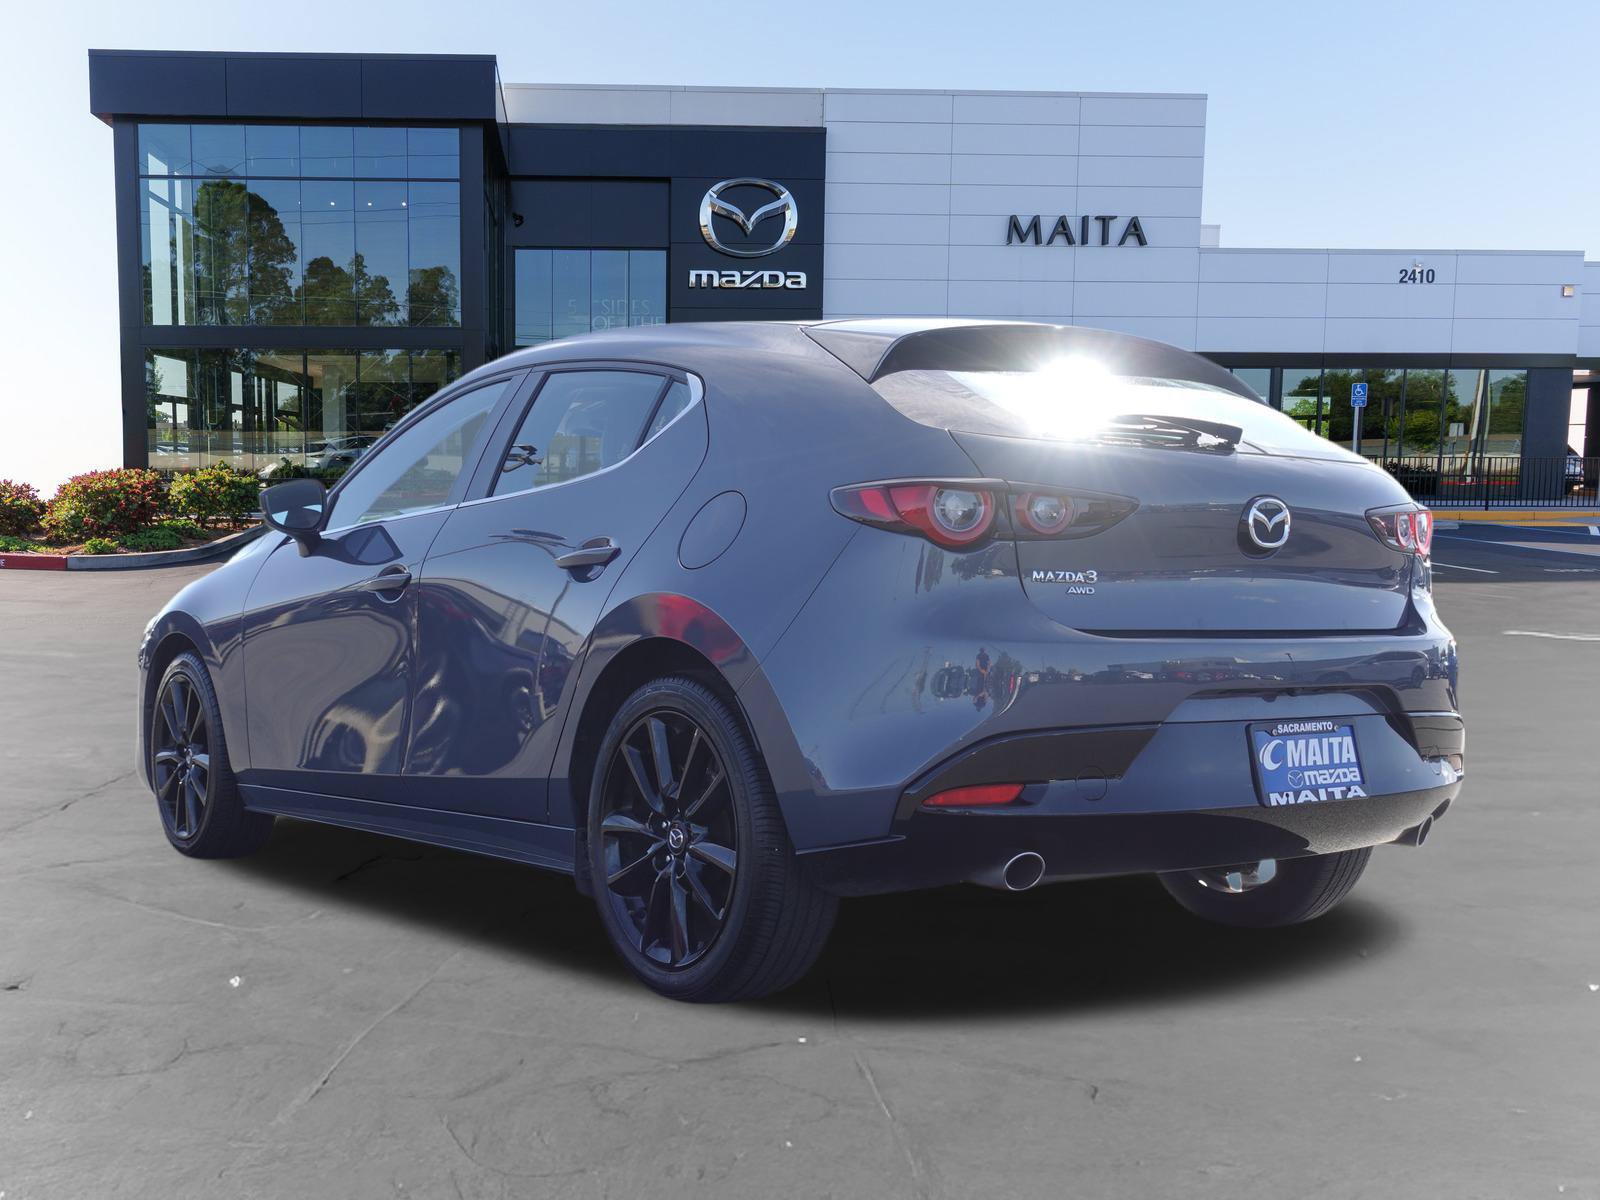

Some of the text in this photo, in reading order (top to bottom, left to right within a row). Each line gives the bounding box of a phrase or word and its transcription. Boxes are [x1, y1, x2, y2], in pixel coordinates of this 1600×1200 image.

[1006, 214, 1148, 246] MAITA
[1398, 268, 1436, 284] 2410
[1067, 586, 1095, 595] AWD
[1277, 721, 1333, 734] SACRAMENTO
[1286, 736, 1357, 768] MAITA
[1269, 785, 1367, 807] MAITA
